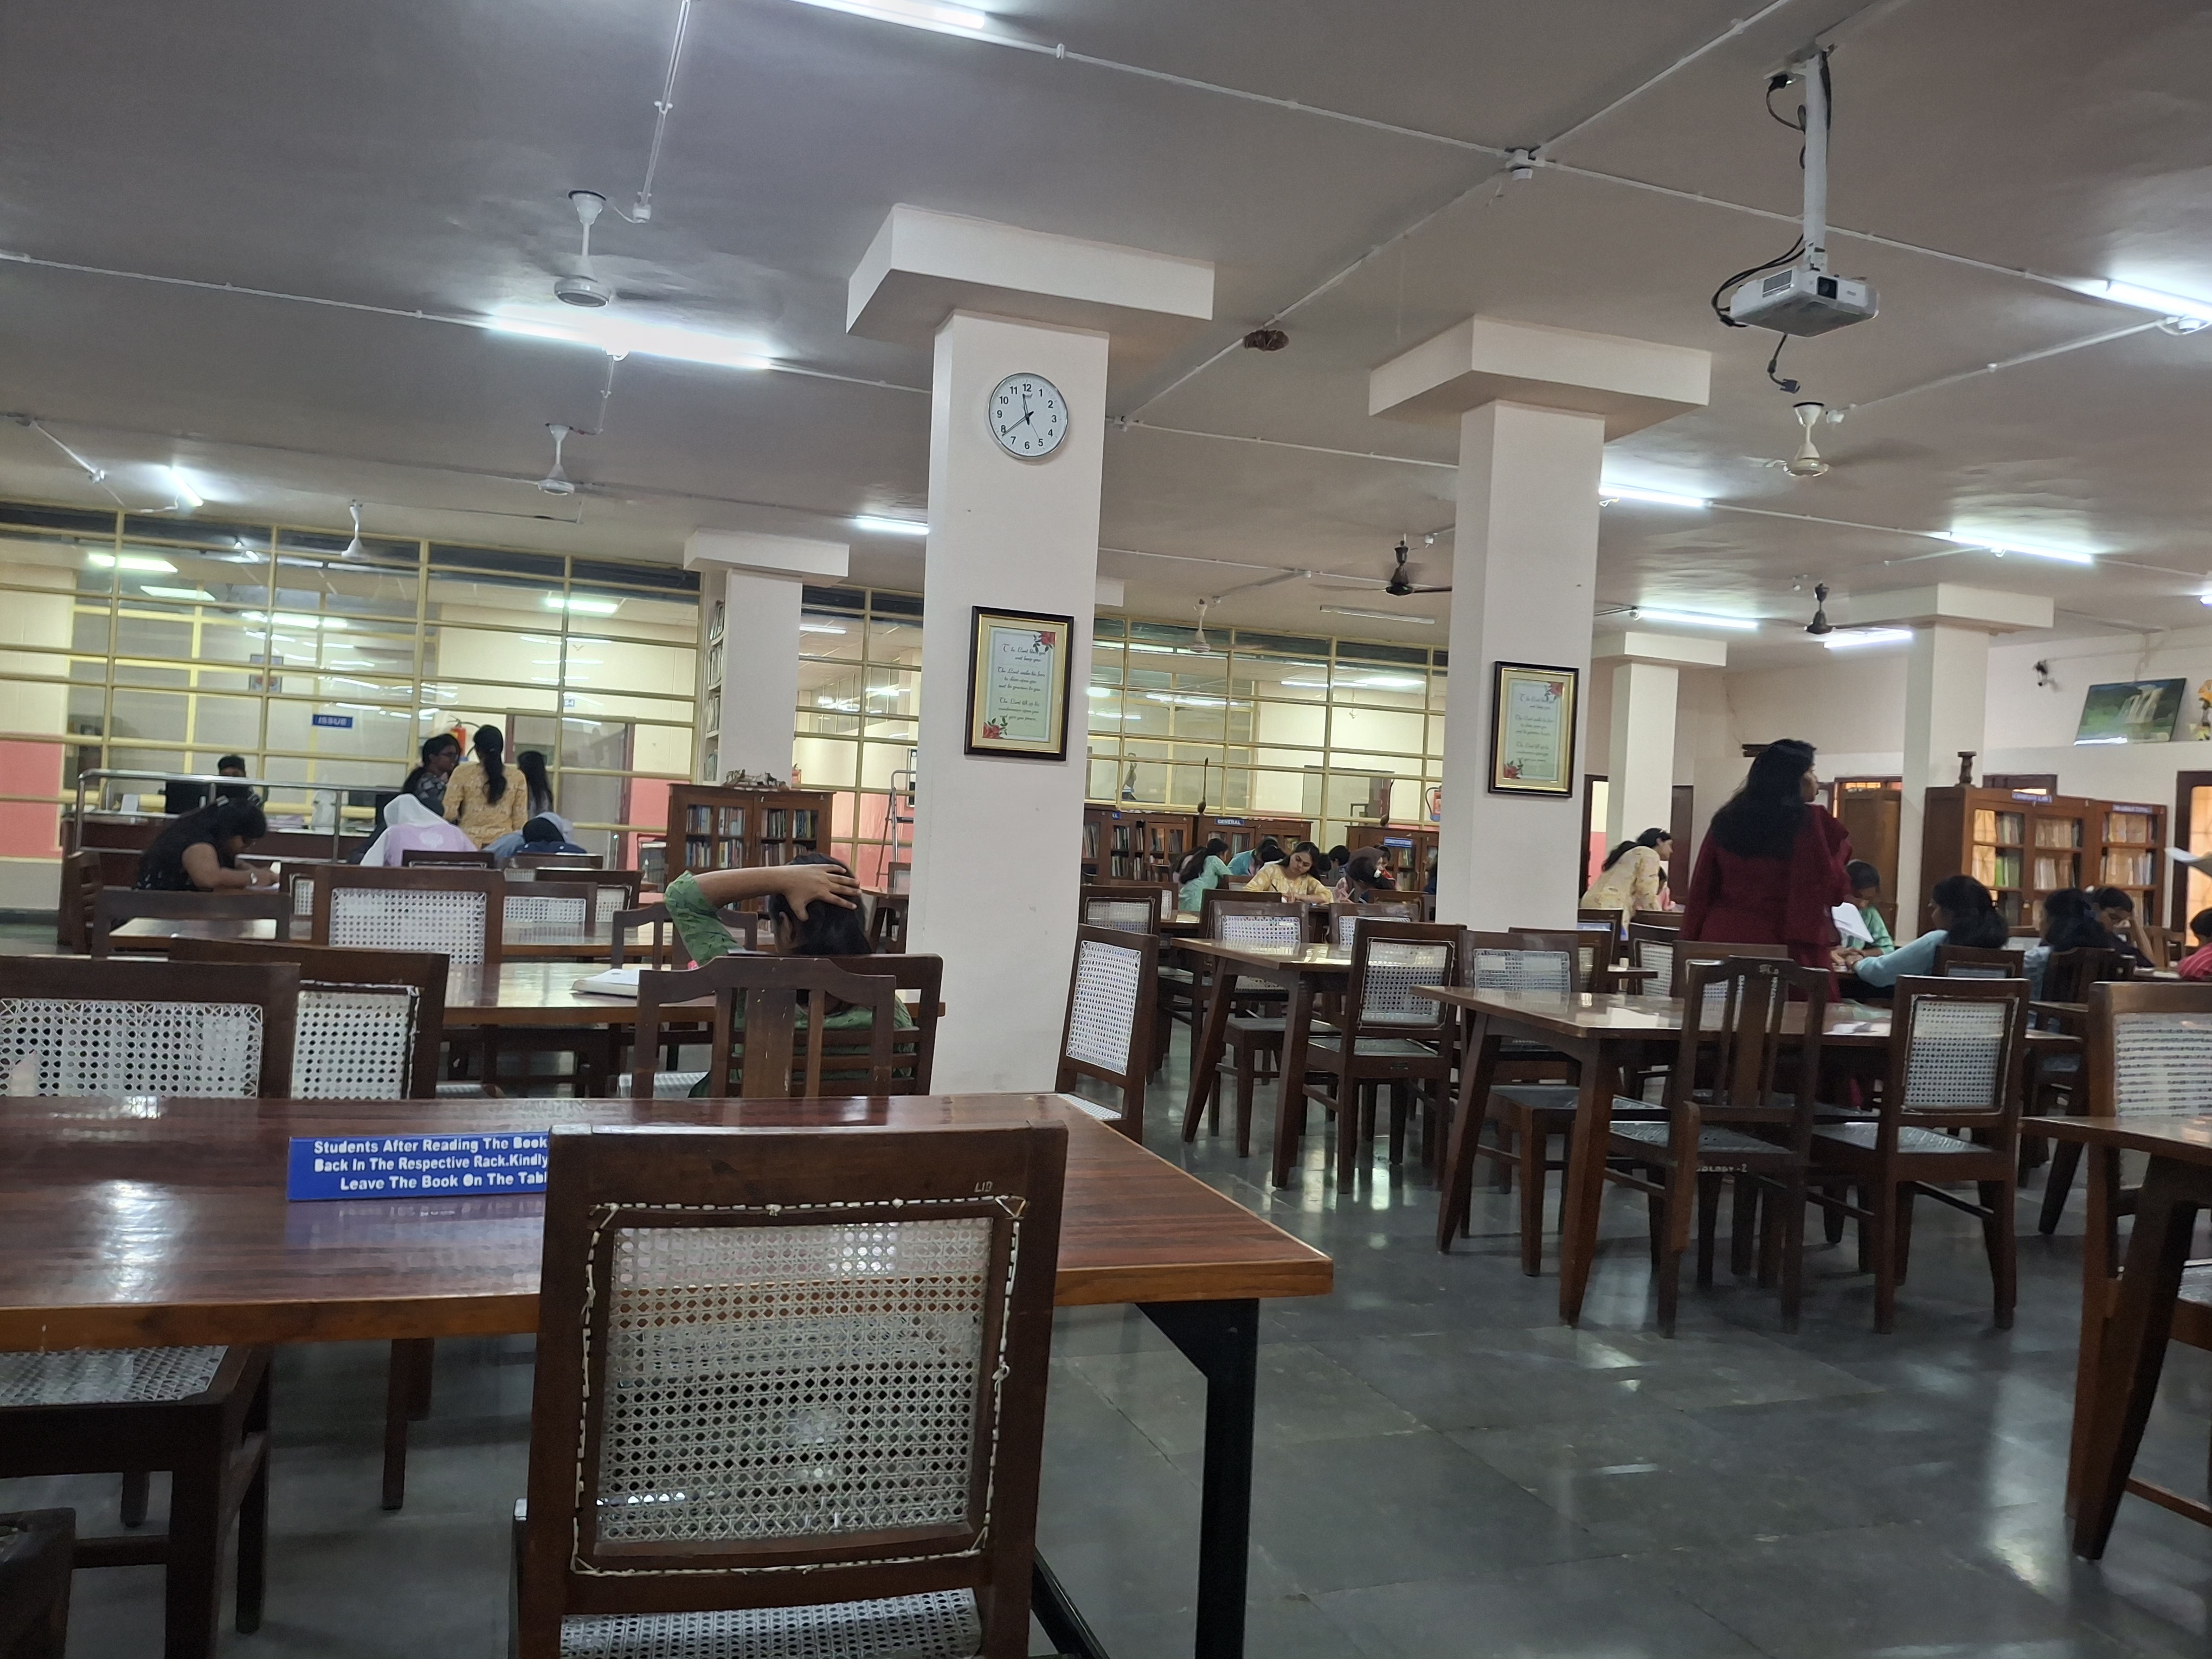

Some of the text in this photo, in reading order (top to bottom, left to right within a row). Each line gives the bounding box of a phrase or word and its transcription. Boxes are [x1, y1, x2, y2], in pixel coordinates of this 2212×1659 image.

[1010, 386, 1018, 395] 11
[1023, 383, 1032, 392] 12
[1039, 388, 1043, 397] 1
[1000, 396, 1008, 404] 10
[1047, 400, 1053, 408] 2
[996, 410, 1002, 419] 9
[1052, 415, 1057, 423] 3
[1001, 425, 1006, 434] 8
[1047, 429, 1053, 437] 4
[1011, 436, 1016, 445] 7
[1025, 441, 1030, 449] 6
[1038, 439, 1043, 447] 5
[314, 1136, 548, 1155] Students After Reading The Book
[314, 1158, 348, 1173] Back
[352, 1158, 365, 1171] In
[369, 1157, 394, 1171] The
[398, 1155, 470, 1172] Respective
[340, 1176, 385, 1191] Leave
[389, 1175, 417, 1189] The
[421, 1174, 459, 1188] Book
[462, 1173, 483, 1187] On
[487, 1172, 514, 1186] The
